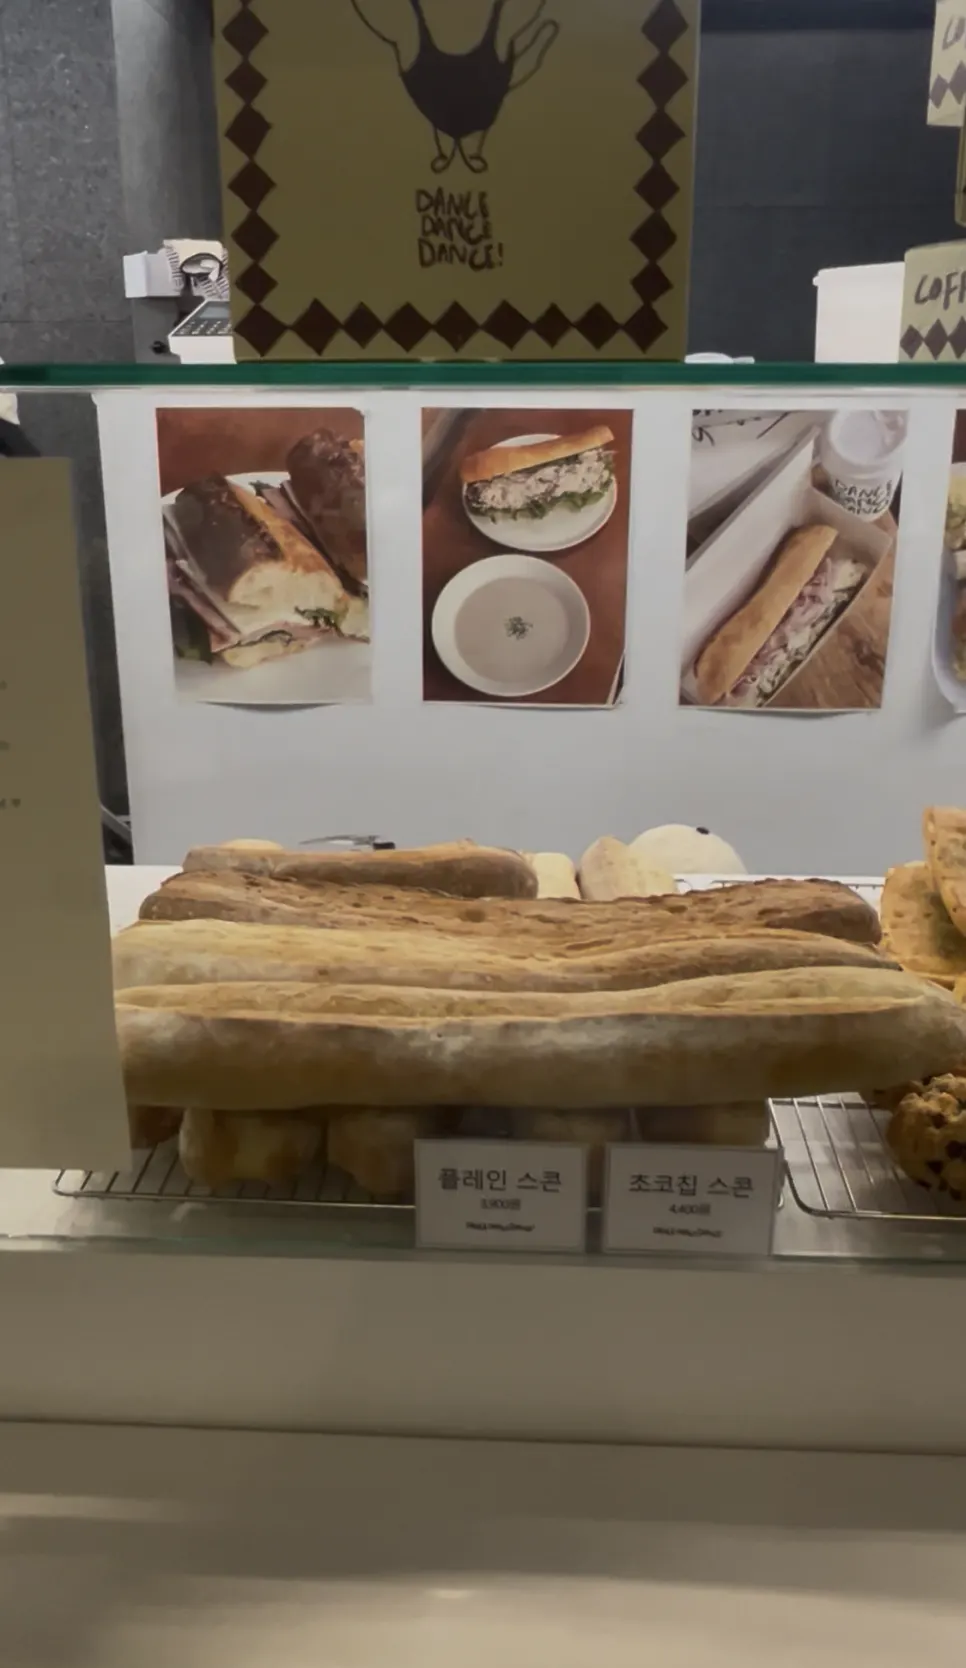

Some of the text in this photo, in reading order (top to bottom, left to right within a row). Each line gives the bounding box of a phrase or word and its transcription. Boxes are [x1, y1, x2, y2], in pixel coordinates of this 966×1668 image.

[415, 186, 489, 220] DANCE
[421, 214, 492, 245] DANCE
[418, 238, 504, 272] DANCE!
[438, 1167, 562, 1193] 플레인 스콘
[628, 1174, 754, 1199] 초코칩 스콘
